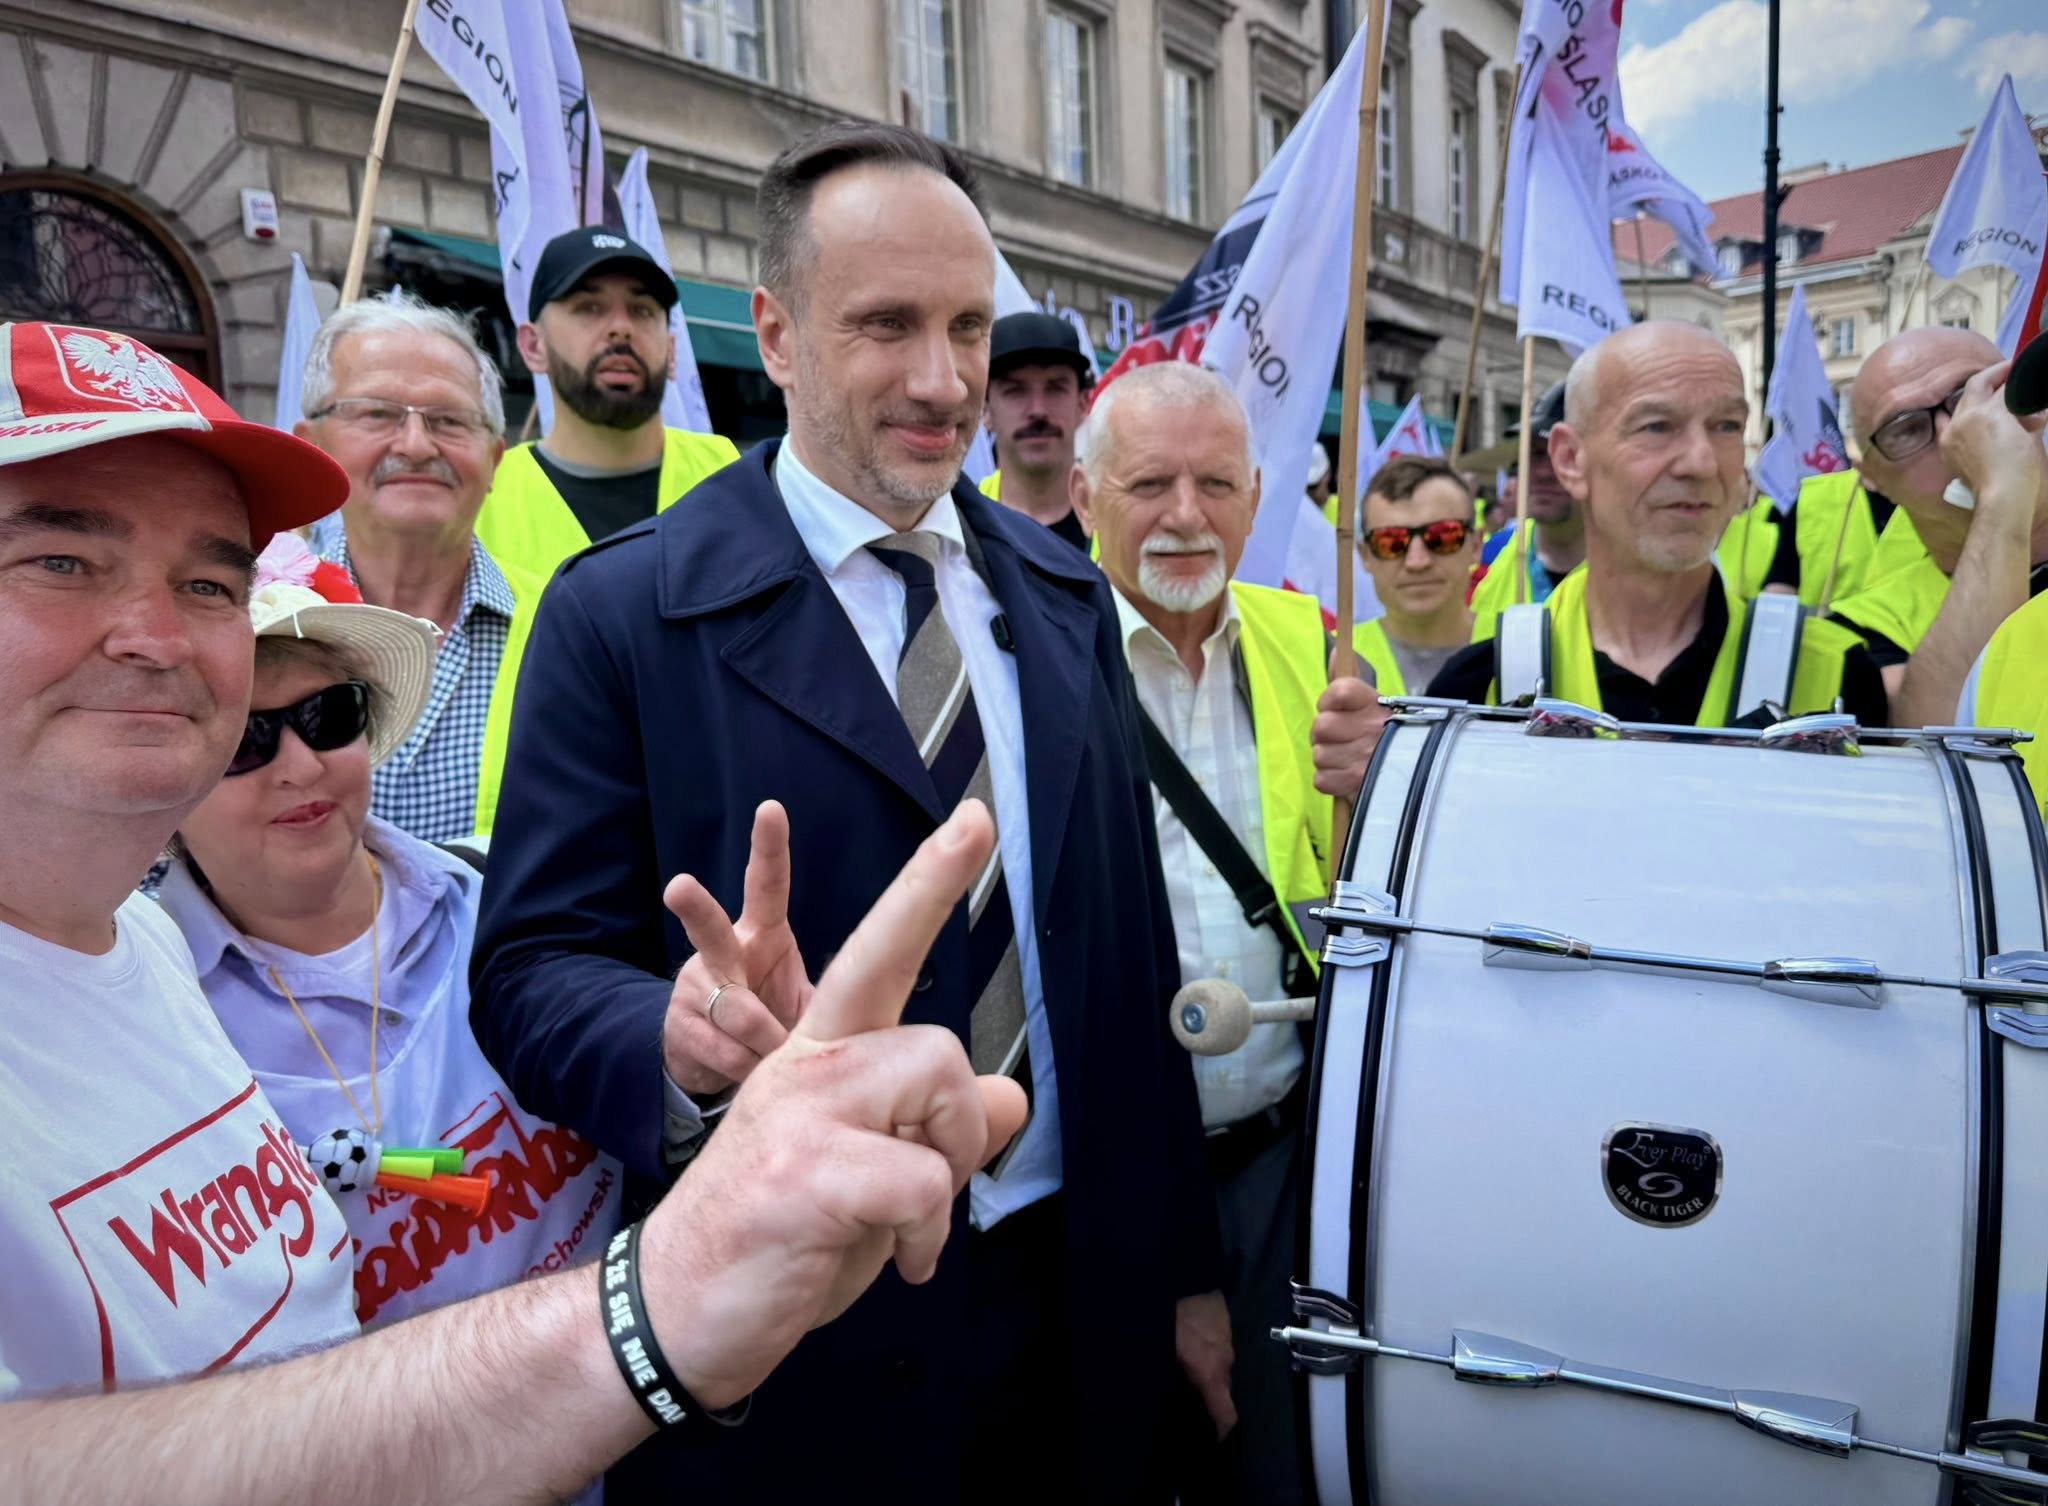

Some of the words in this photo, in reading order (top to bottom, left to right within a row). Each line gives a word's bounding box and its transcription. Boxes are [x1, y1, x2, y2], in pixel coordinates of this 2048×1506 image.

[426, 0, 518, 115] EGION
[1542, 284, 1616, 333] REGI
[1612, 1131, 1668, 1169] Ever
[1671, 1145, 1708, 1171] Play
[106, 1121, 318, 1310] Wrangle
[527, 1167, 614, 1276] ochowski
[1615, 1183, 1659, 1216] BLACK
[1662, 1196, 1705, 1217] TIGER
[621, 1336, 659, 1389] NIE
